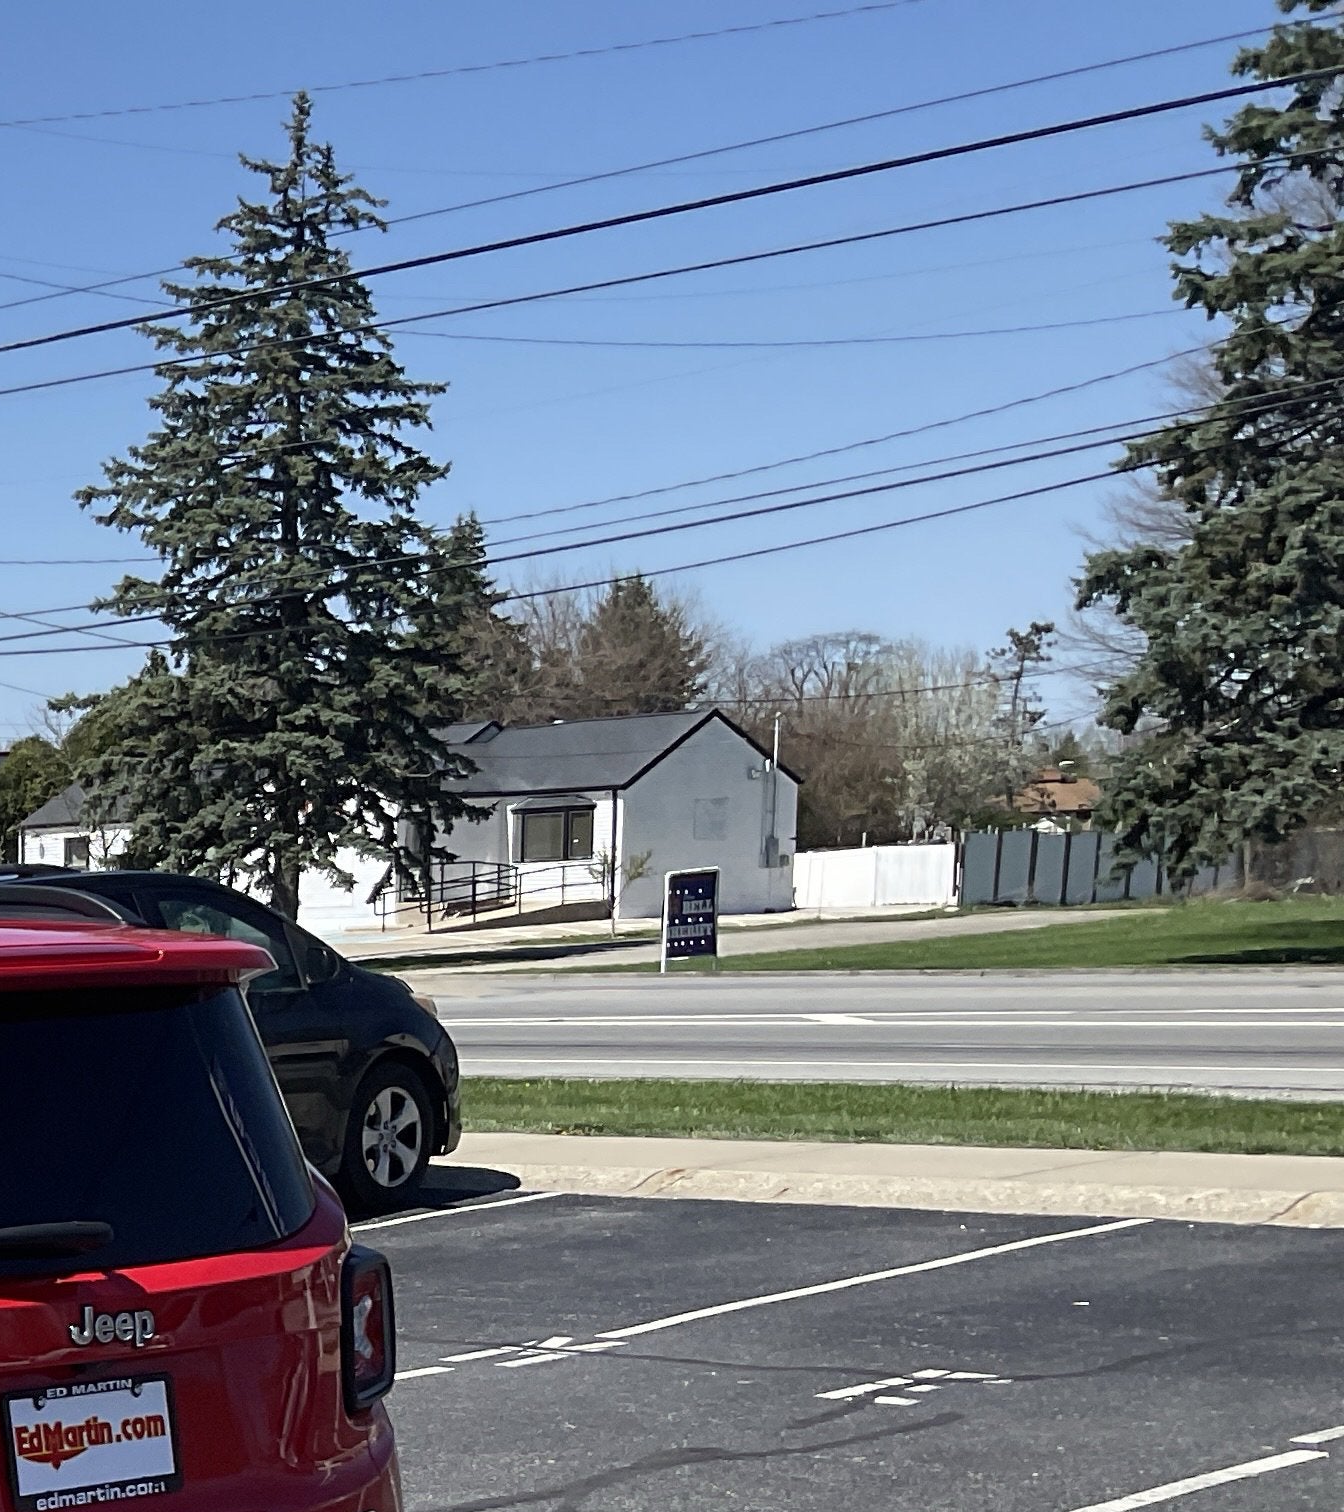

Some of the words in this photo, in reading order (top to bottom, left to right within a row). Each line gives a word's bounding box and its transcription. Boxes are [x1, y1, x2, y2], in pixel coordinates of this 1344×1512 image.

[69, 1306, 155, 1347] Jeep
[46, 1388, 68, 1399] ED
[71, 1378, 133, 1396] MARTIN
[15, 1414, 166, 1457] EdMartin.com
[36, 1481, 165, 1511] edmartin.com
